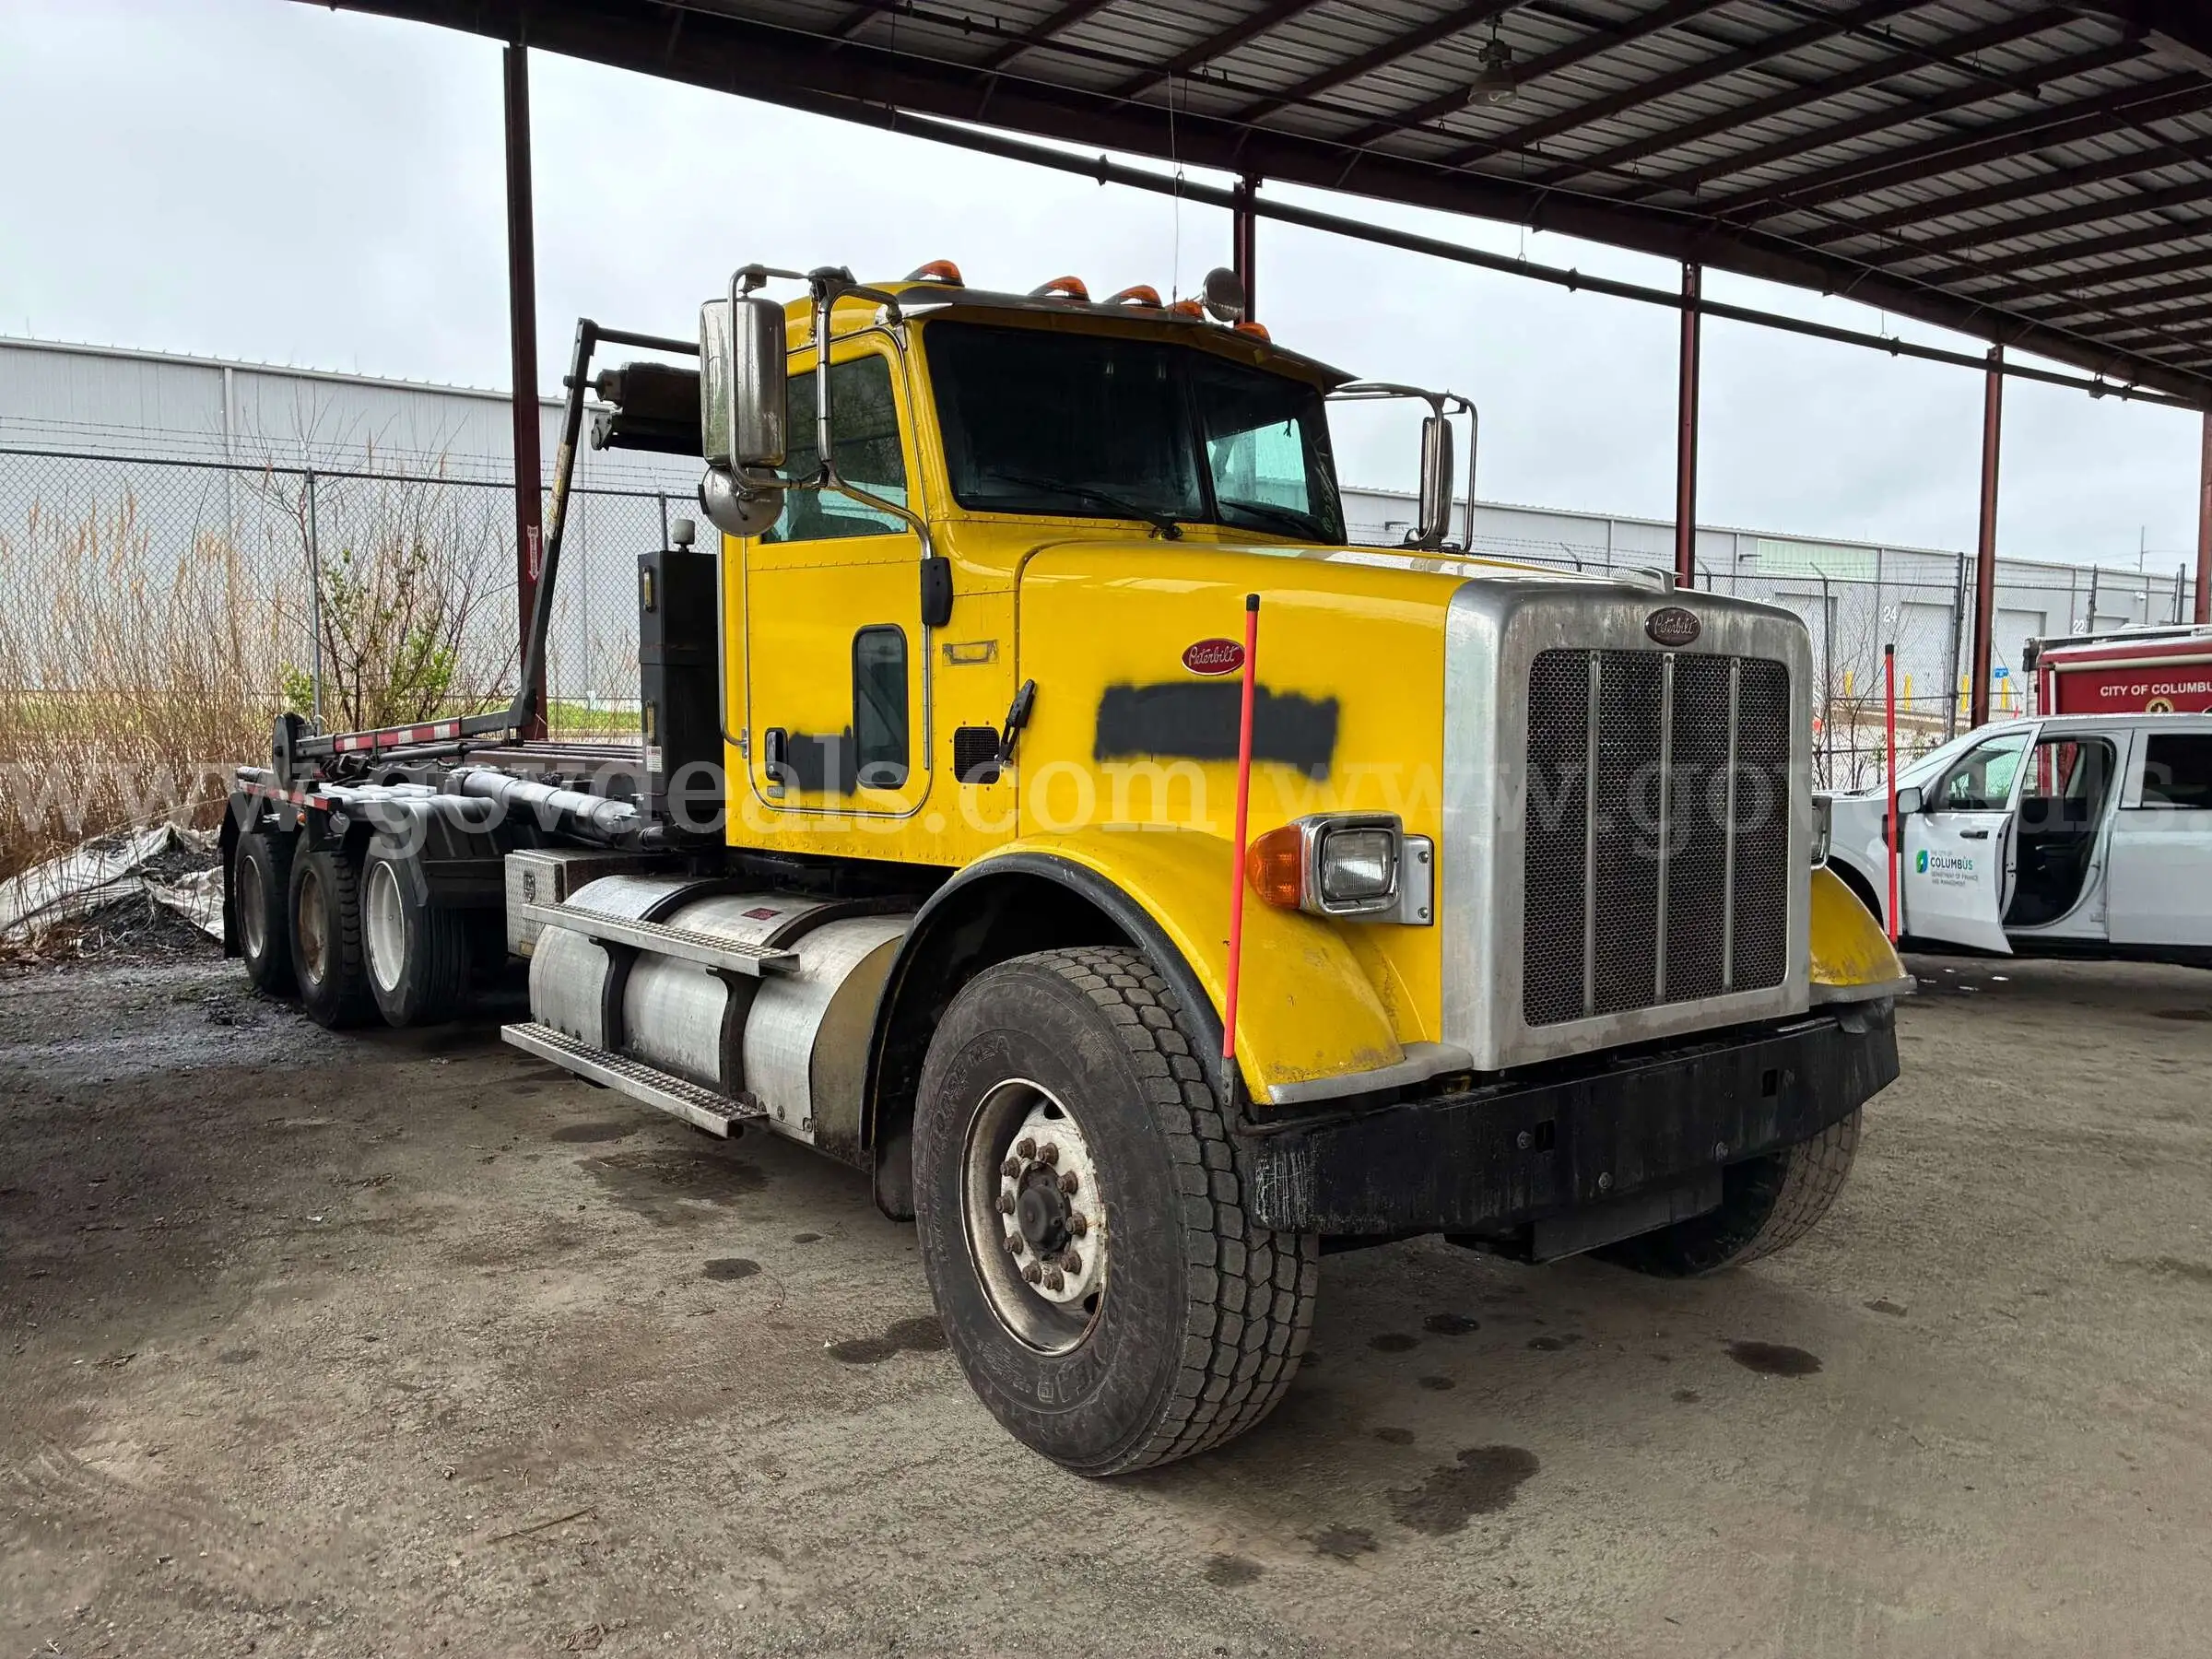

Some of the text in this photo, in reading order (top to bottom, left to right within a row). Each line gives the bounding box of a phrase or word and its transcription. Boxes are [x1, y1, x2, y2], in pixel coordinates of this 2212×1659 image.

[1883, 606, 1898, 622] 24
[1654, 613, 1698, 635] Peterbilt
[2073, 619, 2086, 634] 22
[1188, 645, 1240, 666] Peterbilt
[2100, 686, 2128, 697] CITY
[2130, 684, 2149, 695] OF
[1930, 855, 1973, 871] COLUMBUS
